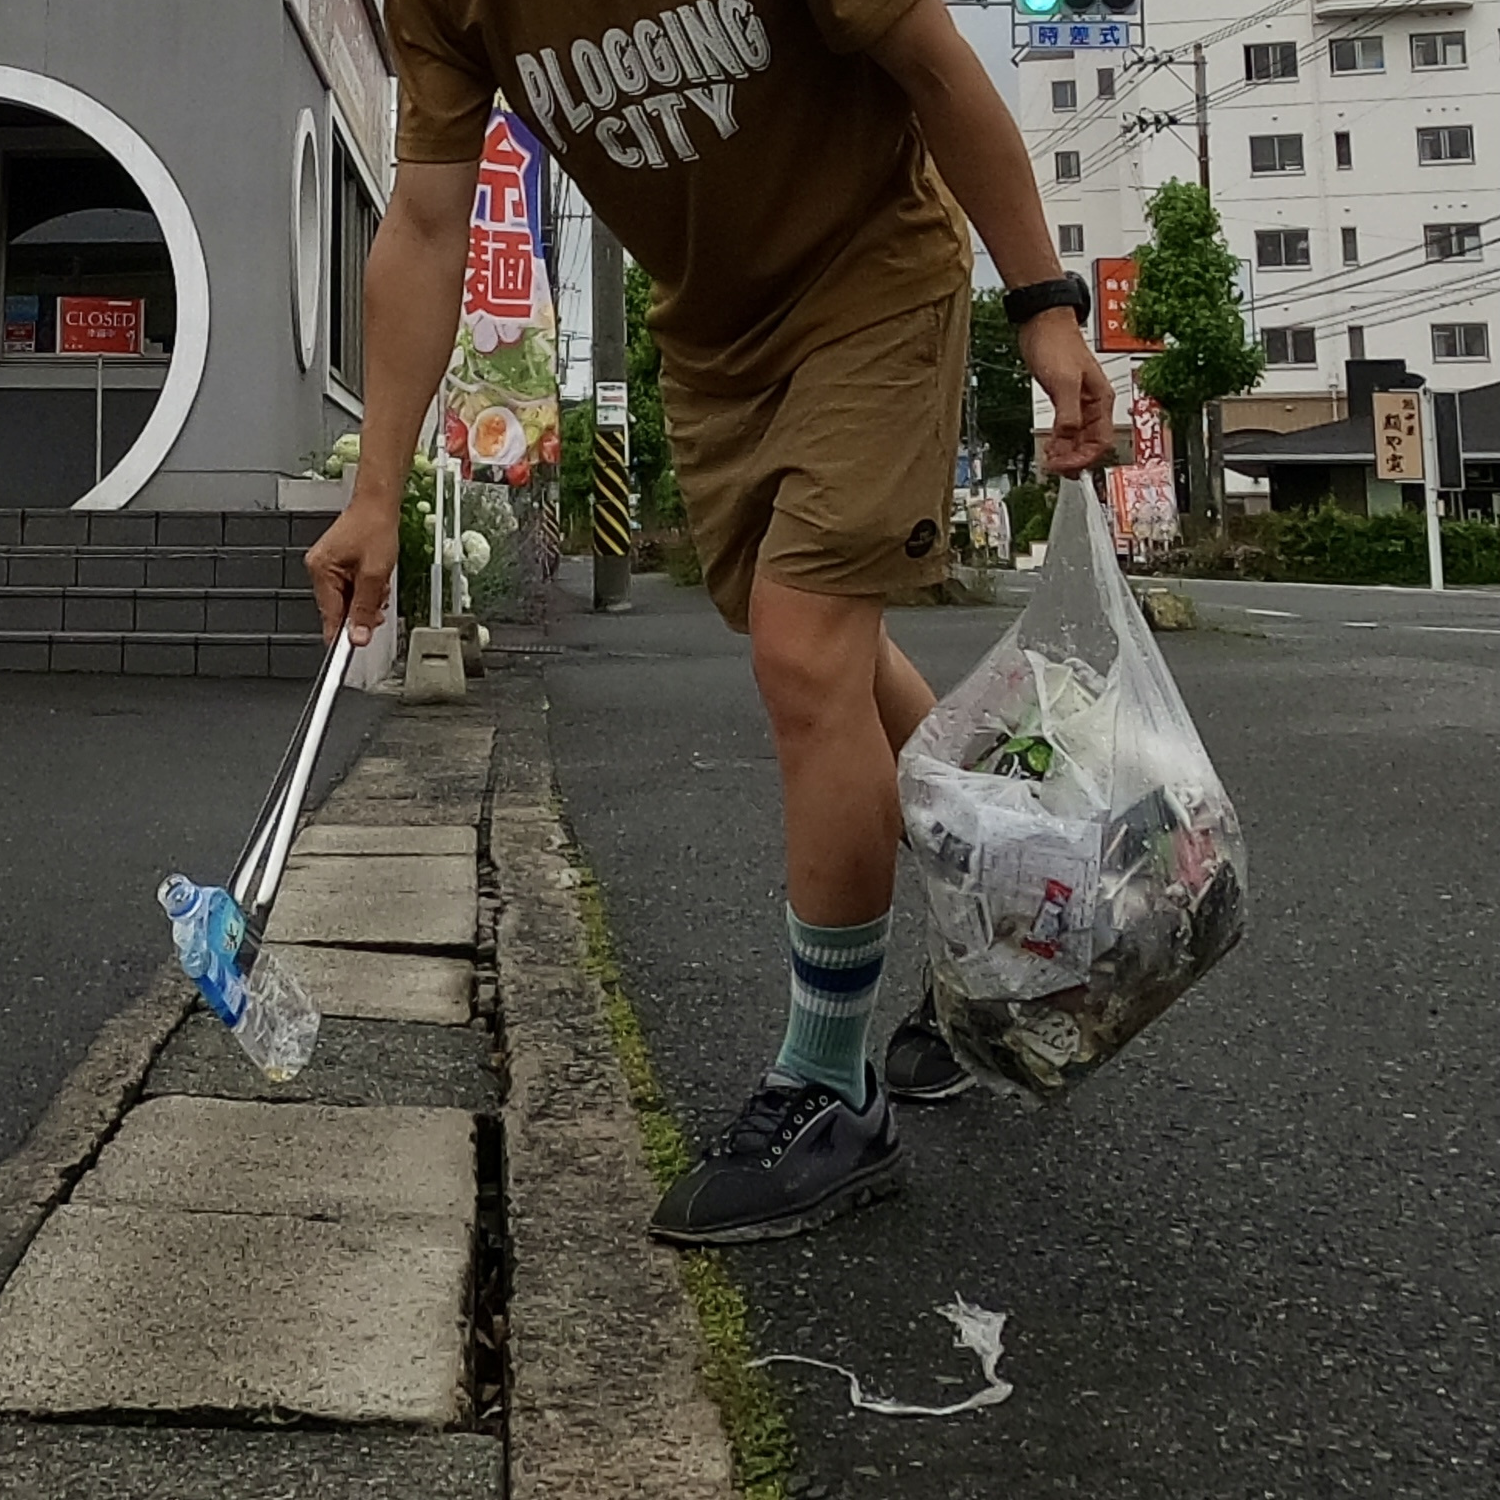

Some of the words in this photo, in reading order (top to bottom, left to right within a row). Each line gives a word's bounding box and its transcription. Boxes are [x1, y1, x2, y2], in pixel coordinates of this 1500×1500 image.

[1037, 23, 1122, 47] 時差式
[594, 83, 740, 168] CITY
[65, 311, 136, 327] CLOSED
